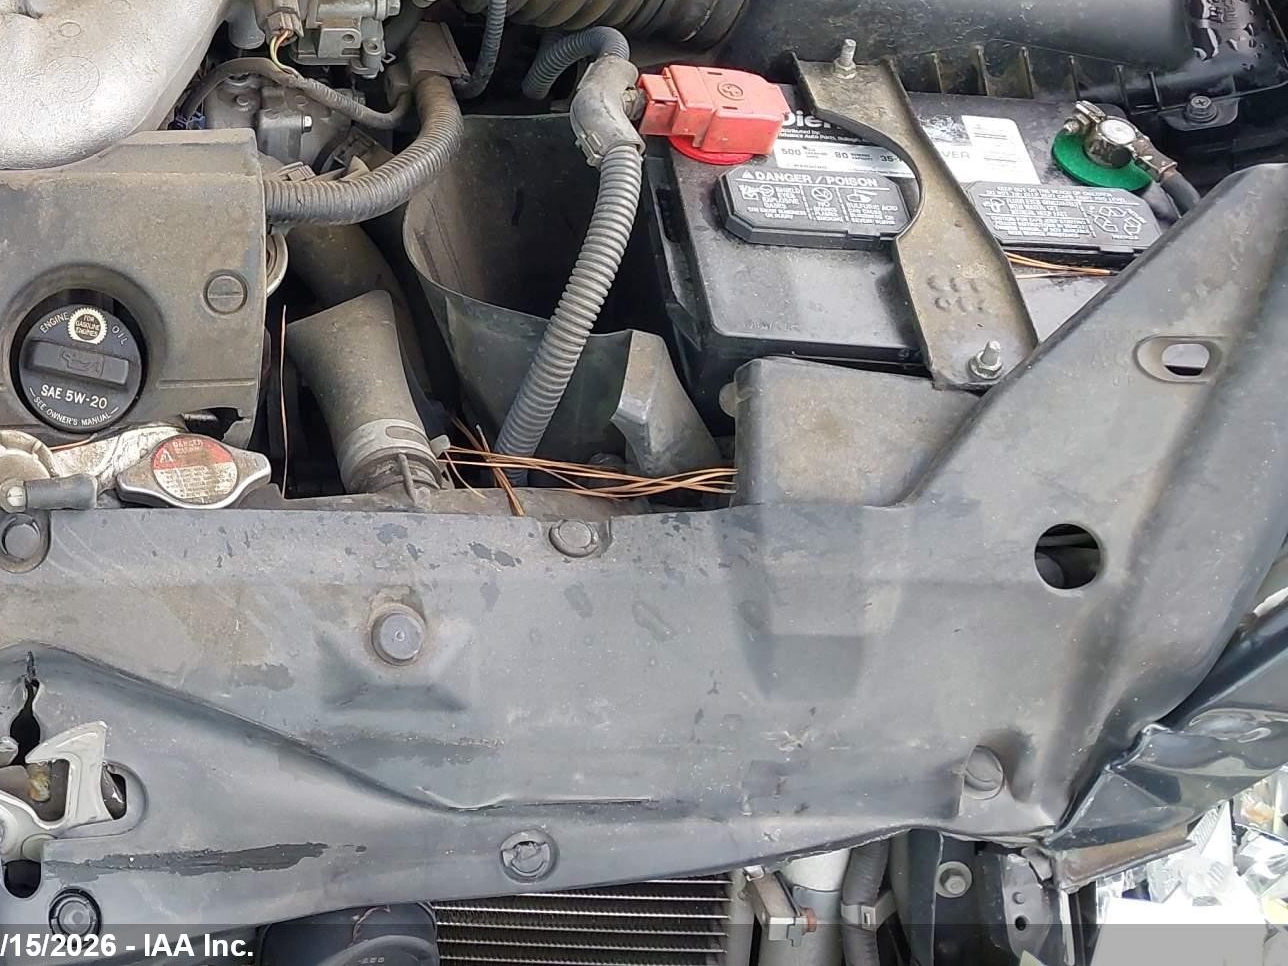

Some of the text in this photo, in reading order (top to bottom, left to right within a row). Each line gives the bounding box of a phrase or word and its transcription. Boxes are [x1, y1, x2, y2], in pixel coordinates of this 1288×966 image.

[942, 150, 970, 159] VER
[754, 170, 812, 184] DANGER
[825, 175, 878, 187] POISON
[75, 320, 101, 331] GASOLINE
[83, 314, 95, 323] FOR
[39, 311, 129, 346] ENGINE OIL
[40, 384, 108, 410] SAE 5W-20
[33, 396, 111, 427] SEE OWNER'S MANUAL
